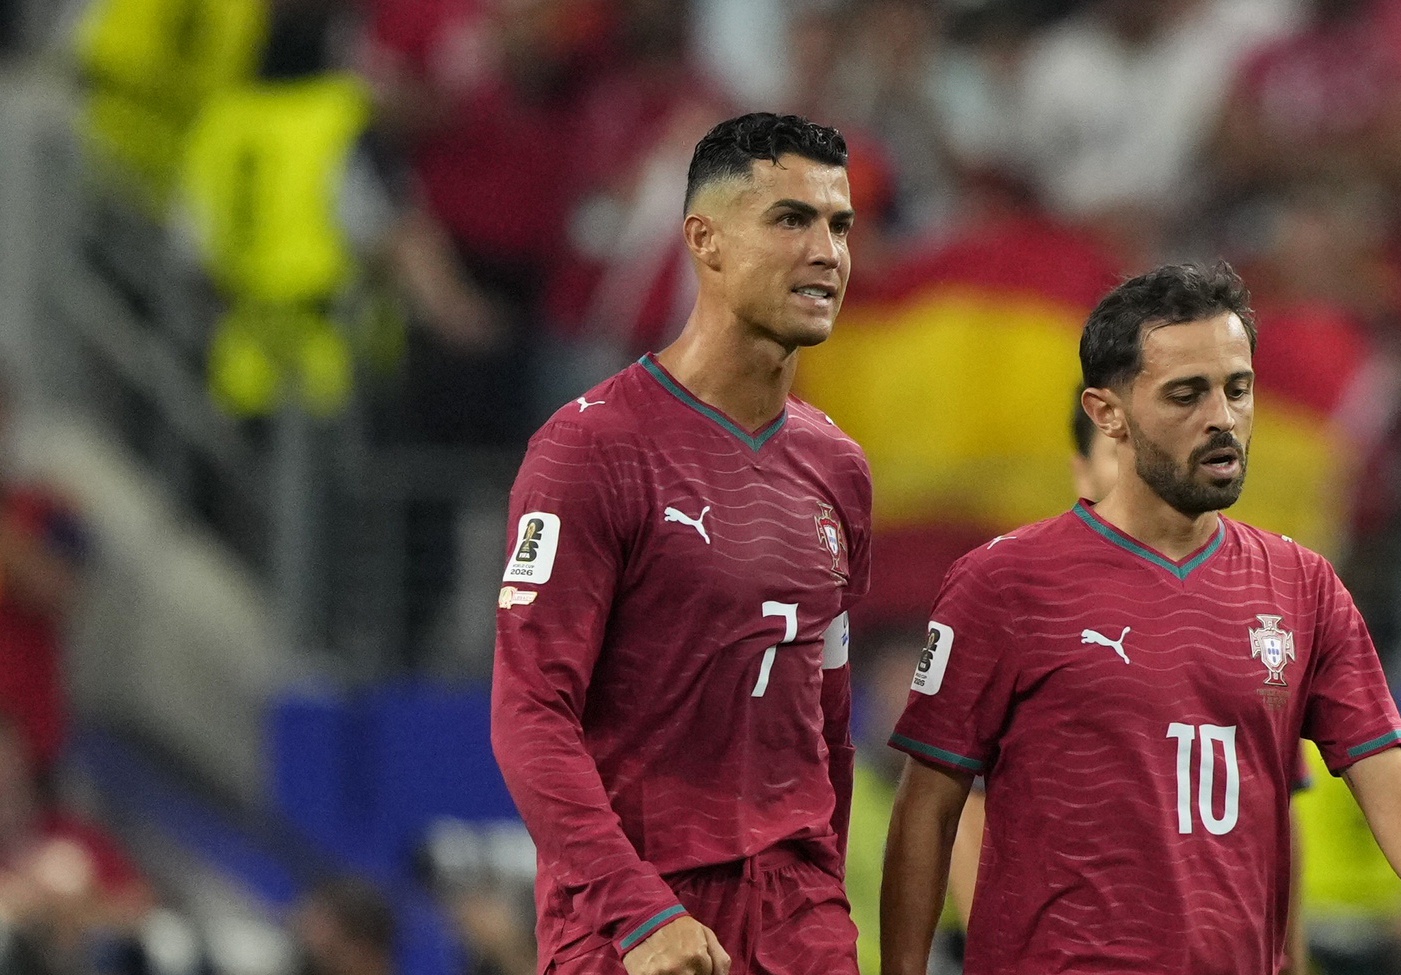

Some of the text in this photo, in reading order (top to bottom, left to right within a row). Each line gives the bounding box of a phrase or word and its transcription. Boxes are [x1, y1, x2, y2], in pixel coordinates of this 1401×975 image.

[510, 568, 533, 576] 2026
[751, 601, 799, 697] 7
[1166, 722, 1240, 835] 10
